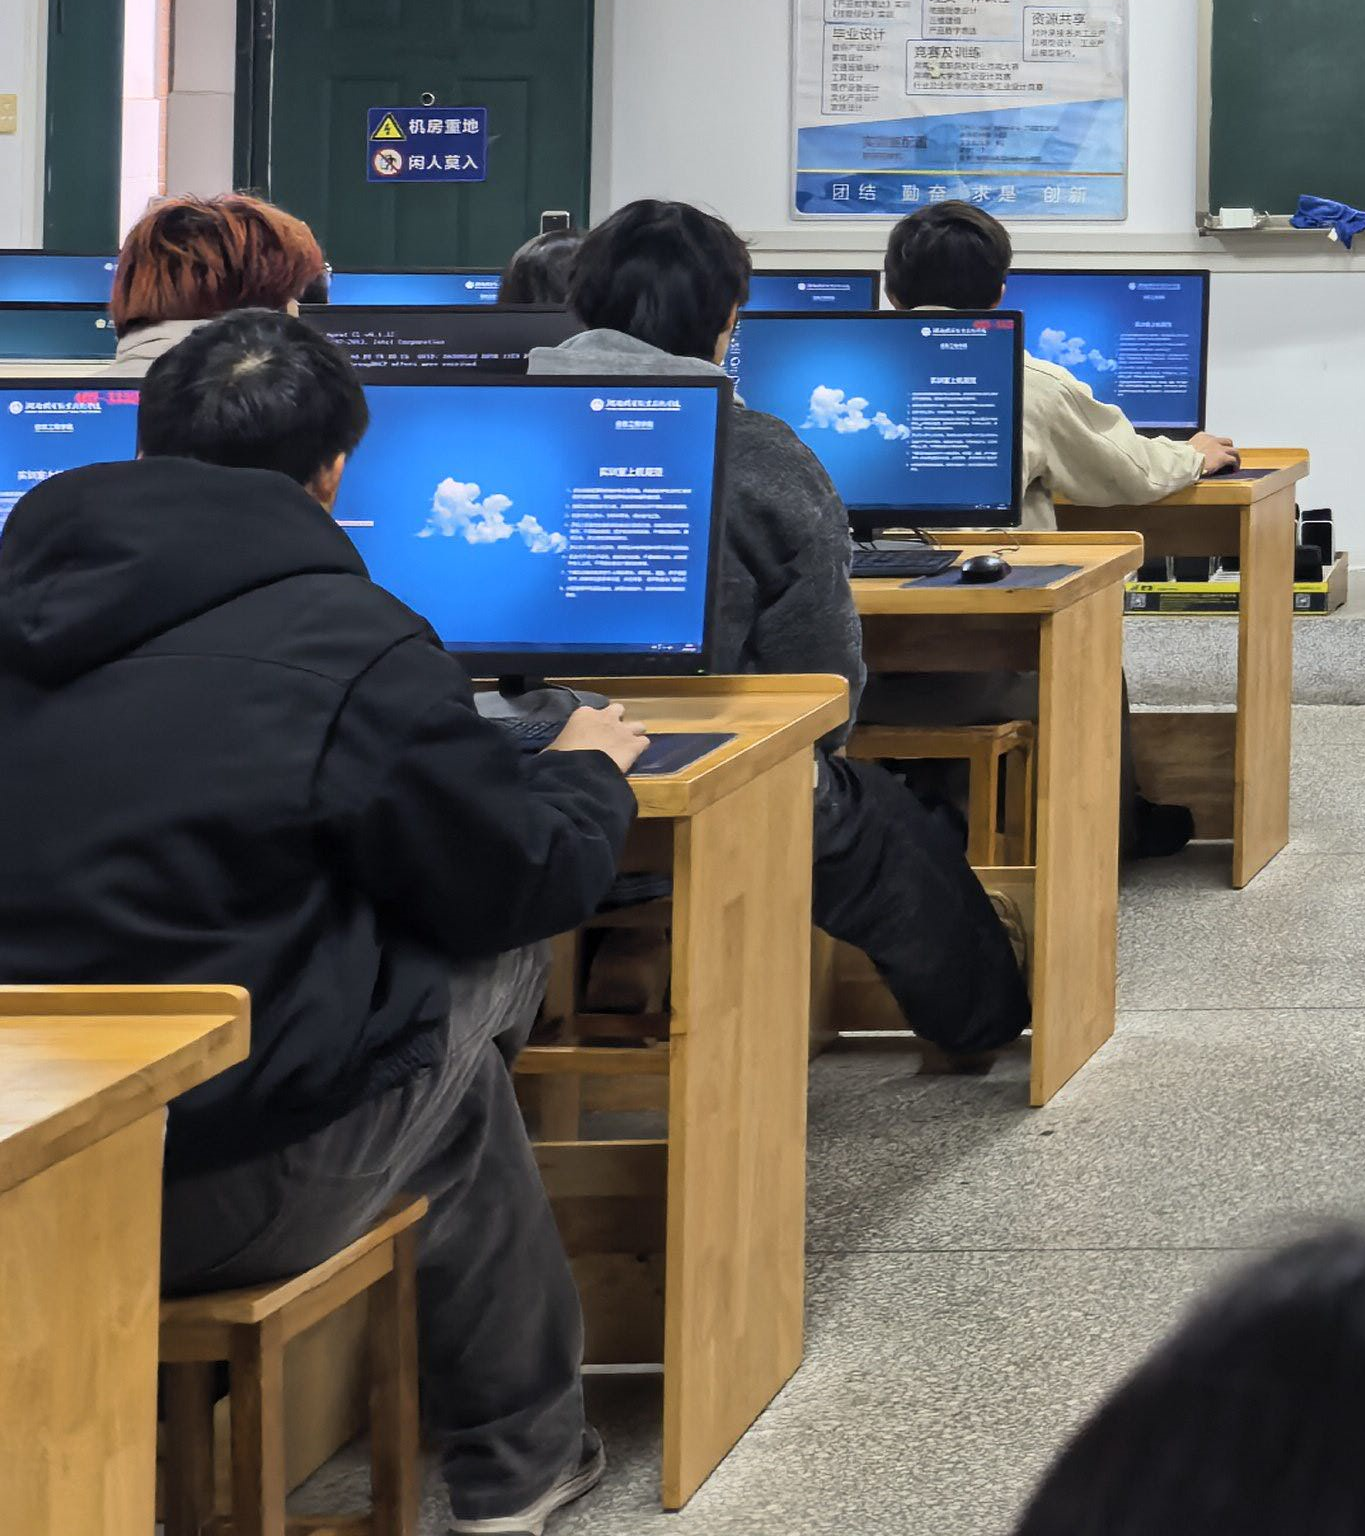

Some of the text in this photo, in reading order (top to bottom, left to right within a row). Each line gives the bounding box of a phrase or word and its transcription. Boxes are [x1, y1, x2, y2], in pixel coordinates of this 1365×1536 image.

[1031, 12, 1087, 26] 资源共享
[832, 27, 886, 41] 毕业设计
[914, 46, 982, 59] 竞赛及训练
[408, 118, 480, 135] 机房重地
[408, 154, 479, 171] 闲人莫入
[832, 183, 1088, 204] 团结 勤奋 求是 创新
